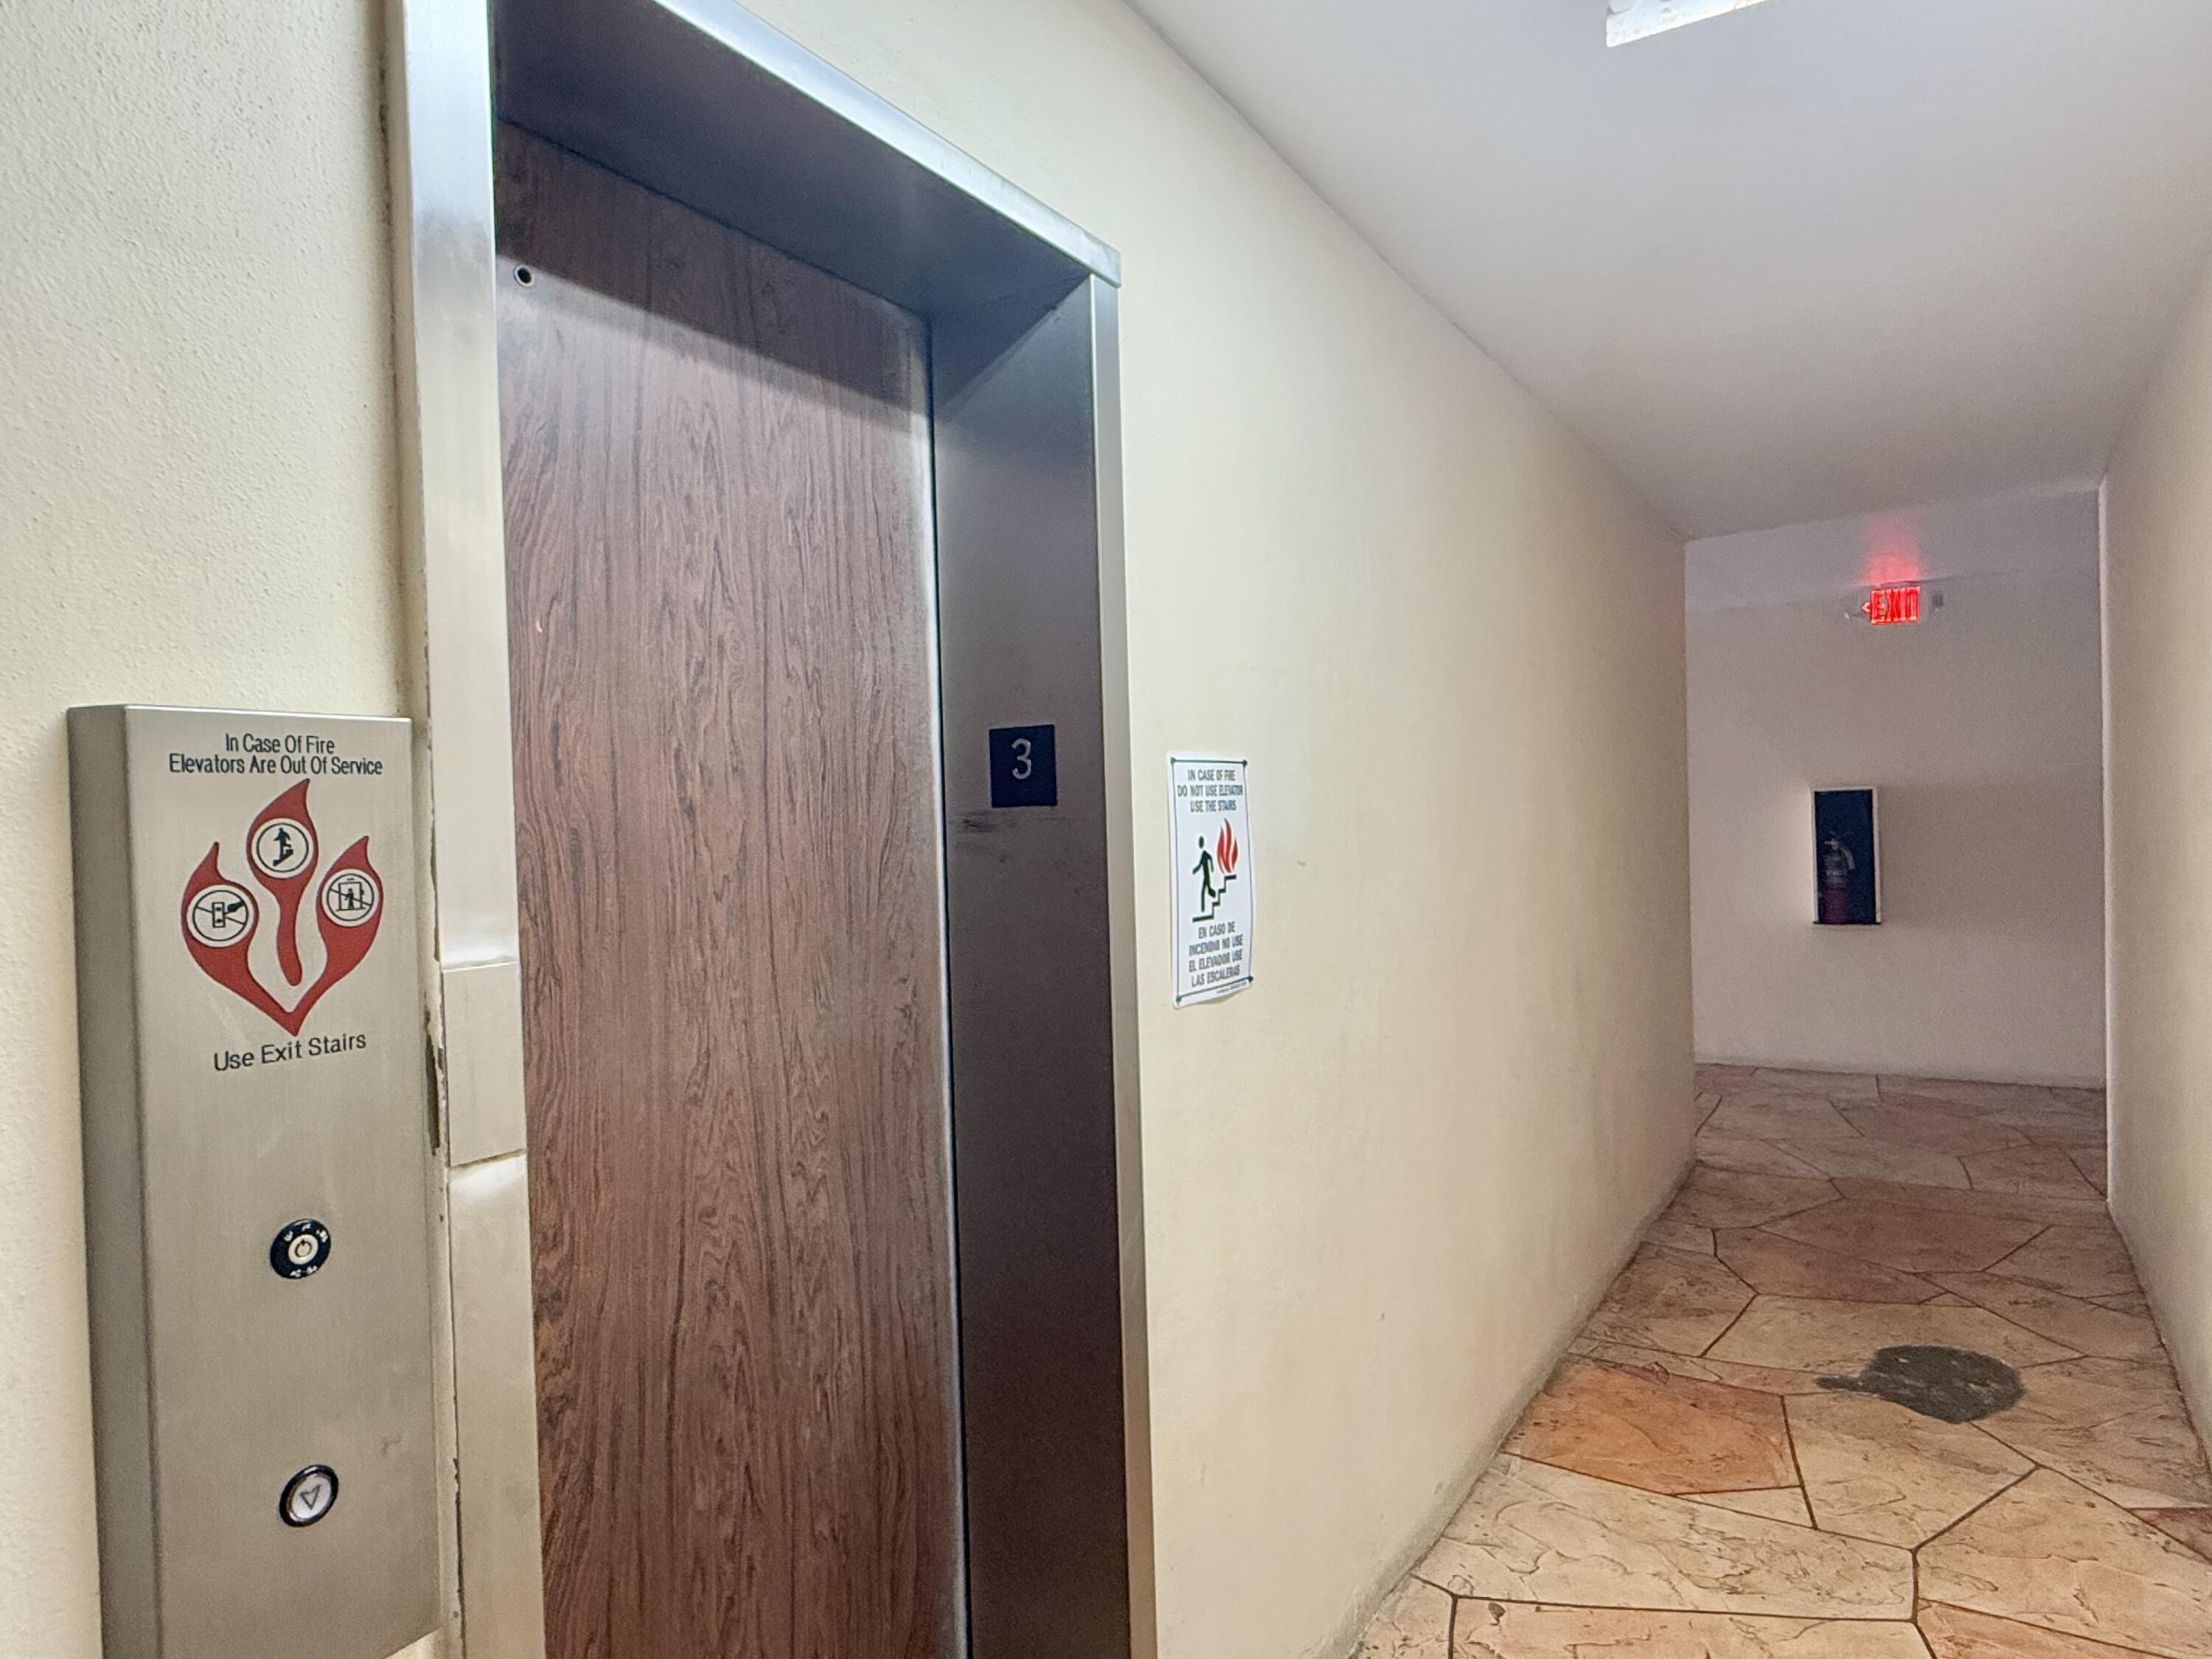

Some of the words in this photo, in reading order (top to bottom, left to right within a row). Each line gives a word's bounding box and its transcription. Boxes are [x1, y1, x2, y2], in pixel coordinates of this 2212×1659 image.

[1871, 586, 1920, 625] EXIT
[226, 733, 239, 751] In
[243, 733, 280, 753] Case
[285, 734, 302, 753] Of
[306, 735, 335, 754] Fire
[169, 753, 245, 773] Elevators
[249, 755, 276, 773] Are
[280, 755, 307, 774] Out
[310, 756, 327, 774] Of
[331, 756, 383, 775] Service
[1012, 738, 1032, 780] 3
[1187, 769, 1196, 781] IN
[1197, 769, 1215, 782] CASE
[1216, 770, 1223, 782] OF
[1224, 770, 1236, 782] FIRE
[1177, 785, 1188, 797] DO
[1189, 785, 1204, 796] NOT
[1205, 785, 1218, 797] USE
[1219, 785, 1243, 796] ELEVATOR
[1189, 800, 1204, 813] USE
[1205, 799, 1217, 812] THE
[1217, 799, 1237, 812] STAIRS
[1198, 927, 1207, 939] EN
[1209, 922, 1225, 937] CASO
[1228, 921, 1236, 933] DE
[1189, 939, 1220, 956] INCENDIO
[1222, 937, 1230, 949] NO
[1231, 933, 1243, 947] USE
[1189, 960, 1197, 973] EL
[1198, 952, 1231, 970] ELEVADOR
[1231, 948, 1242, 962] USE
[1192, 973, 1205, 987] LAS
[1207, 964, 1240, 984] ESCALERAS
[214, 1051, 254, 1071] Use
[261, 1041, 302, 1064] Exit
[308, 1034, 366, 1056] Stairs
